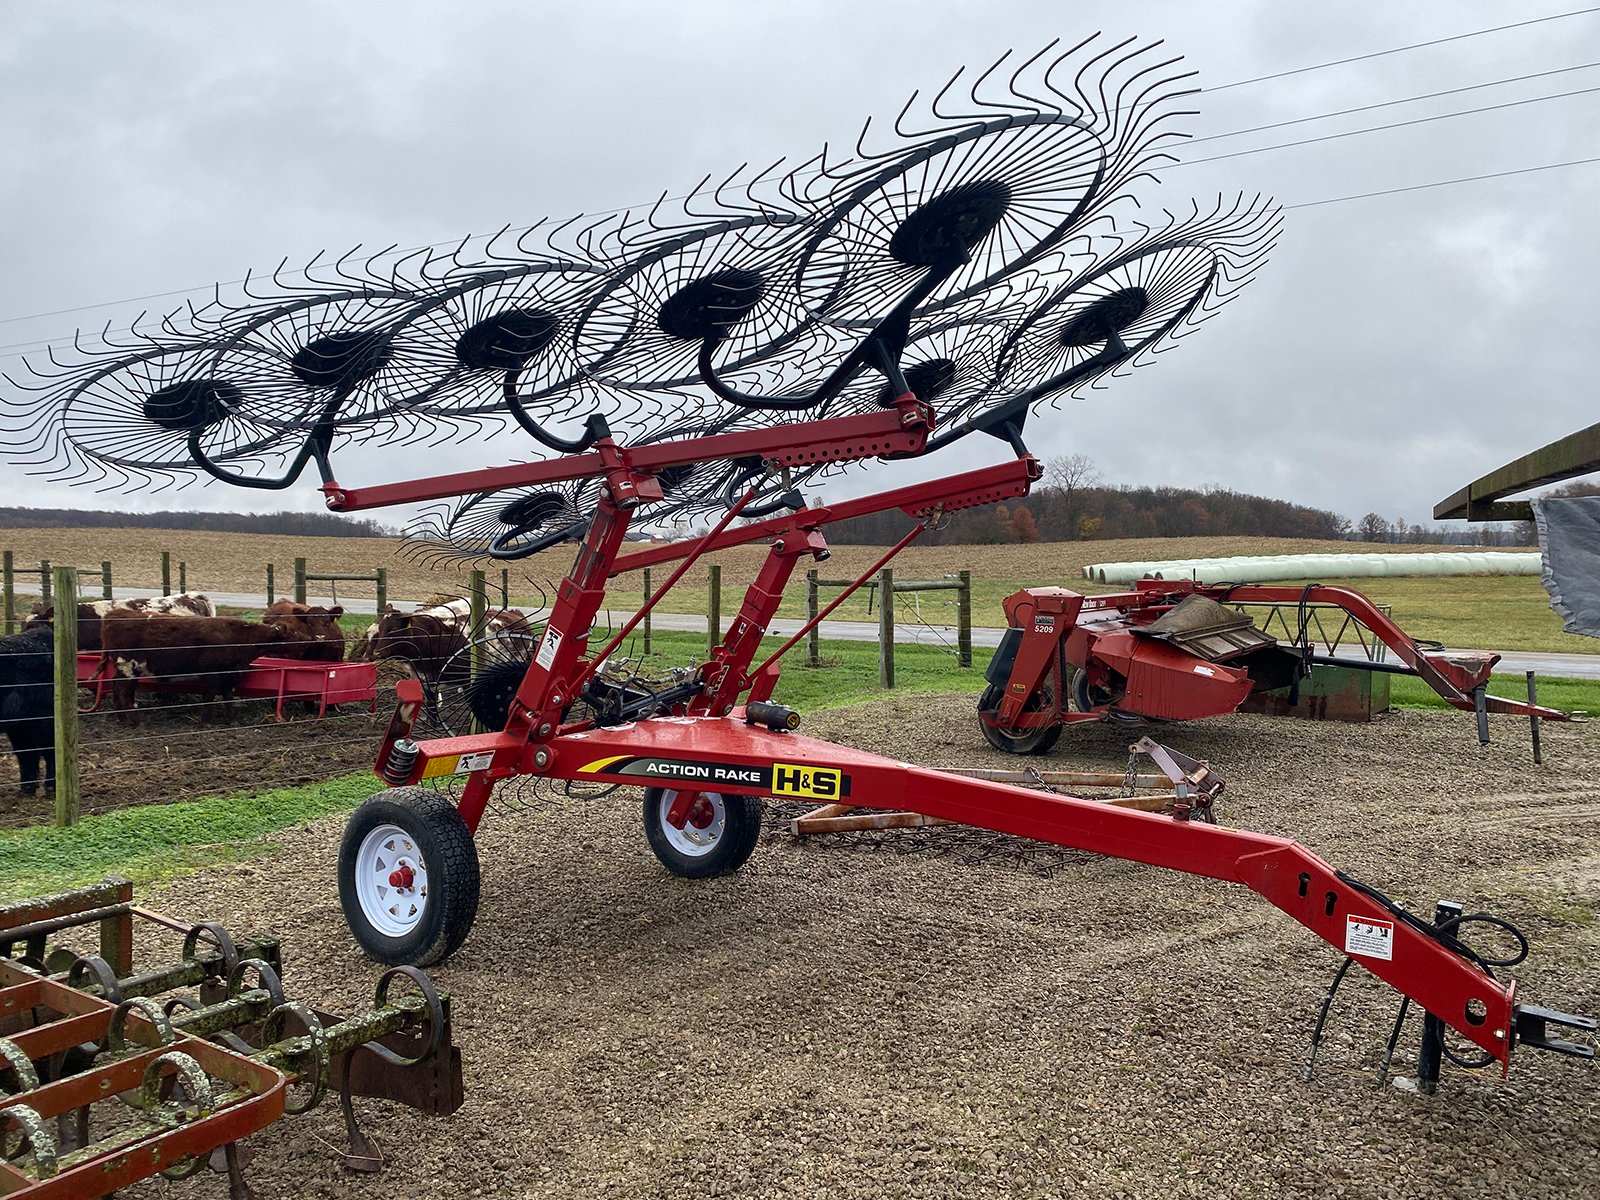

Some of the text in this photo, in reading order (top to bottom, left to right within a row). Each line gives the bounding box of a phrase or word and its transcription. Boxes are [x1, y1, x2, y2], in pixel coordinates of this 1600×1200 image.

[1034, 624, 1054, 634] 5209
[646, 763, 761, 782] ACTION RAKE
[776, 768, 837, 796] H&S
